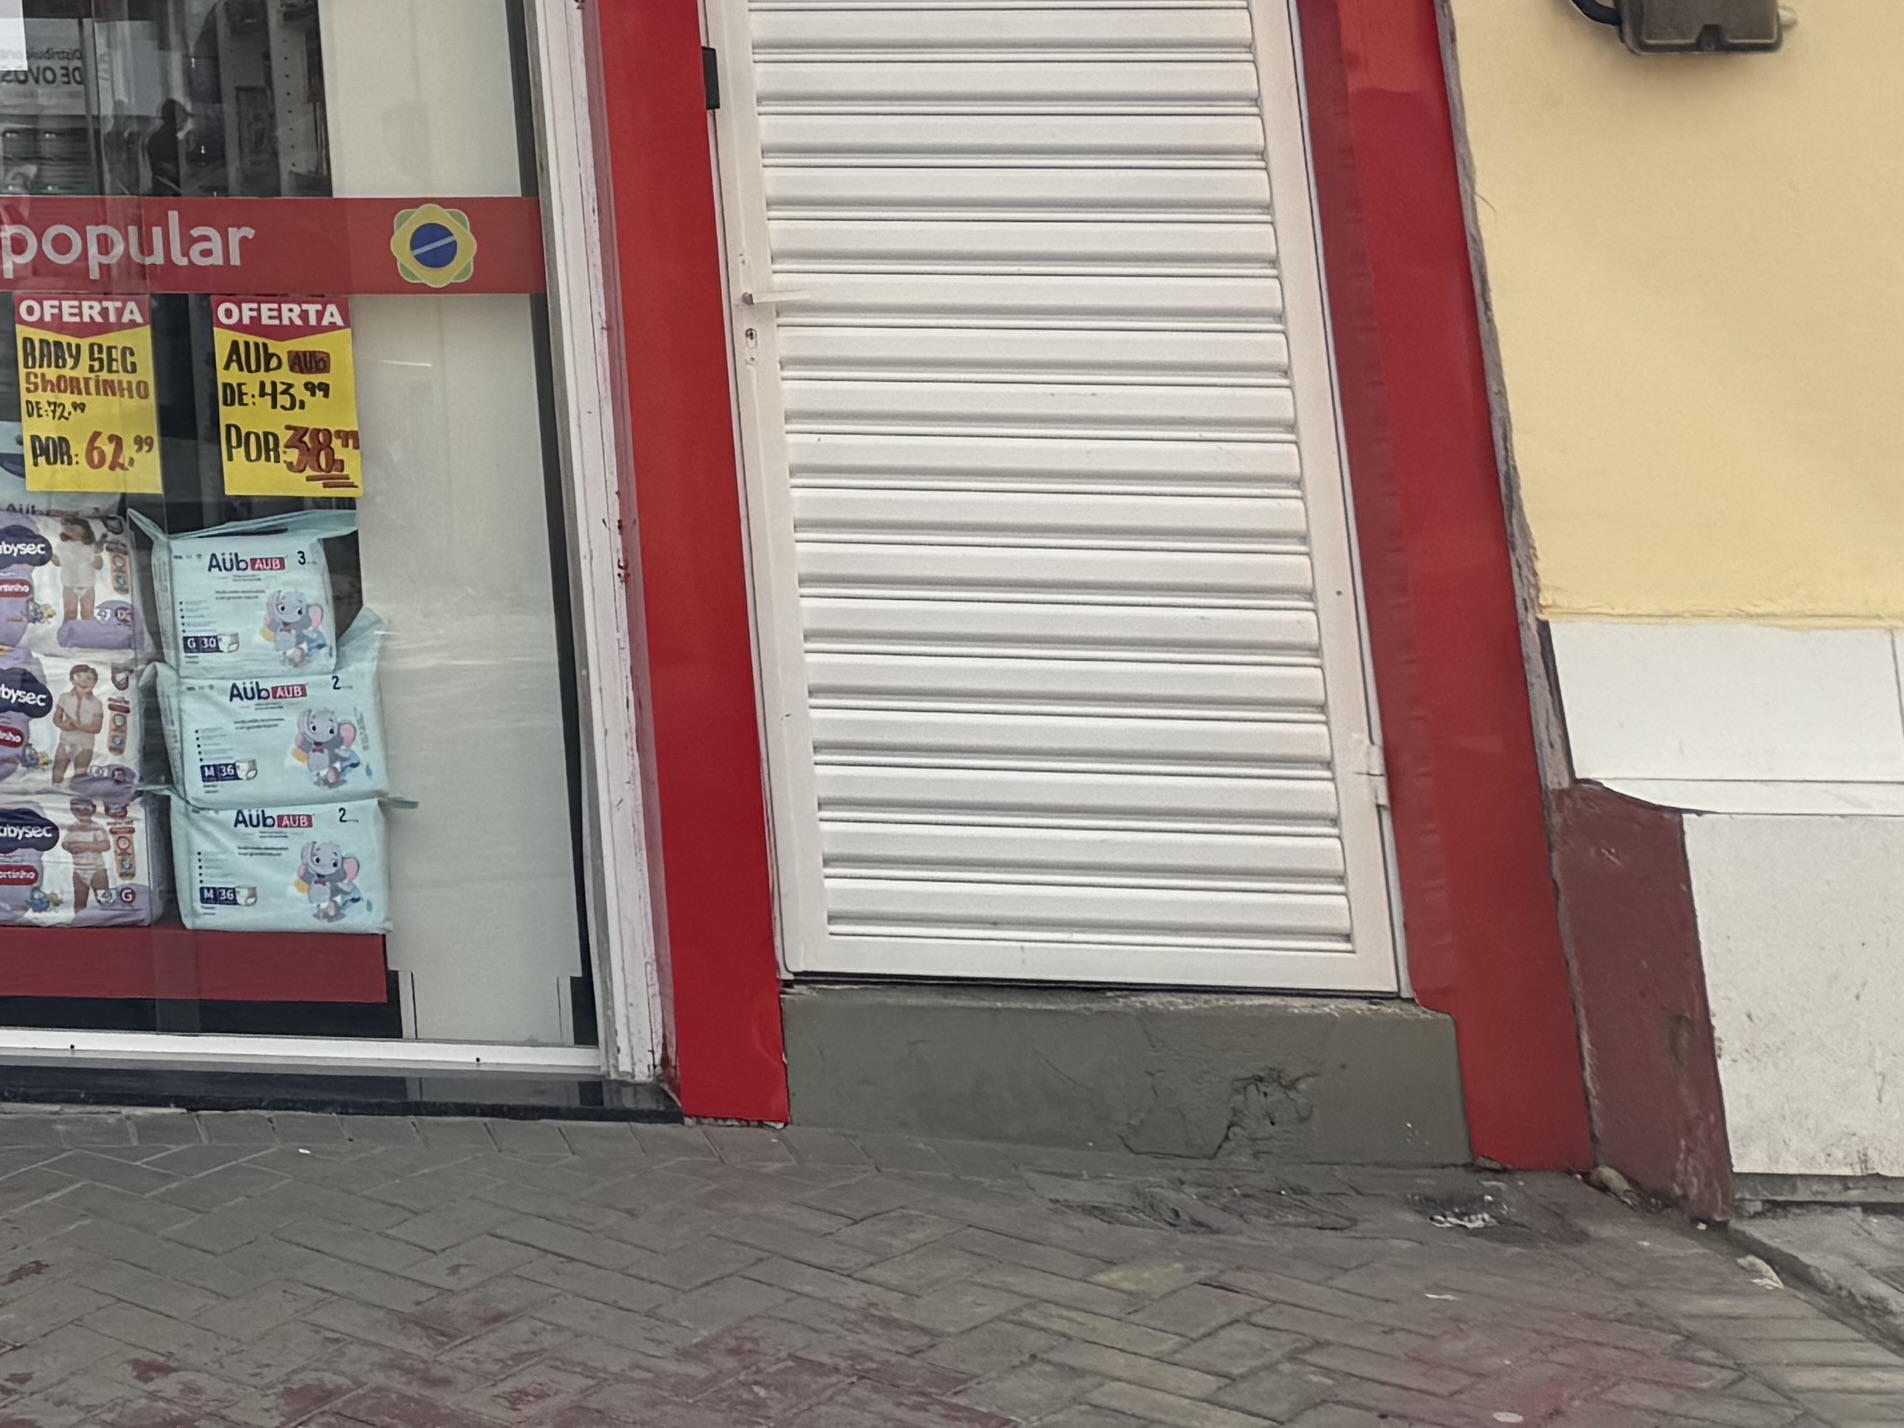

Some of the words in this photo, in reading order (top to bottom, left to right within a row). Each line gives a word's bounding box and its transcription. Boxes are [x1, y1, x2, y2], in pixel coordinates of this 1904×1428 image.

[0, 210, 256, 280] popular
[19, 299, 144, 323] OFERTA
[217, 302, 345, 327] OFERTA
[22, 337, 81, 370] BABY
[88, 342, 137, 374] SEC
[208, 552, 249, 572] Aüb
[254, 559, 281, 570] AUB
[297, 550, 306, 565] 3
[201, 638, 217, 648] 30
[229, 681, 270, 702] Aüb
[276, 686, 303, 698] AUB
[332, 675, 341, 690] 2
[220, 765, 235, 775] 36
[234, 809, 276, 828] Aüb
[281, 816, 309, 827] AUB
[339, 807, 347, 823] 2
[219, 889, 234, 900] 36
